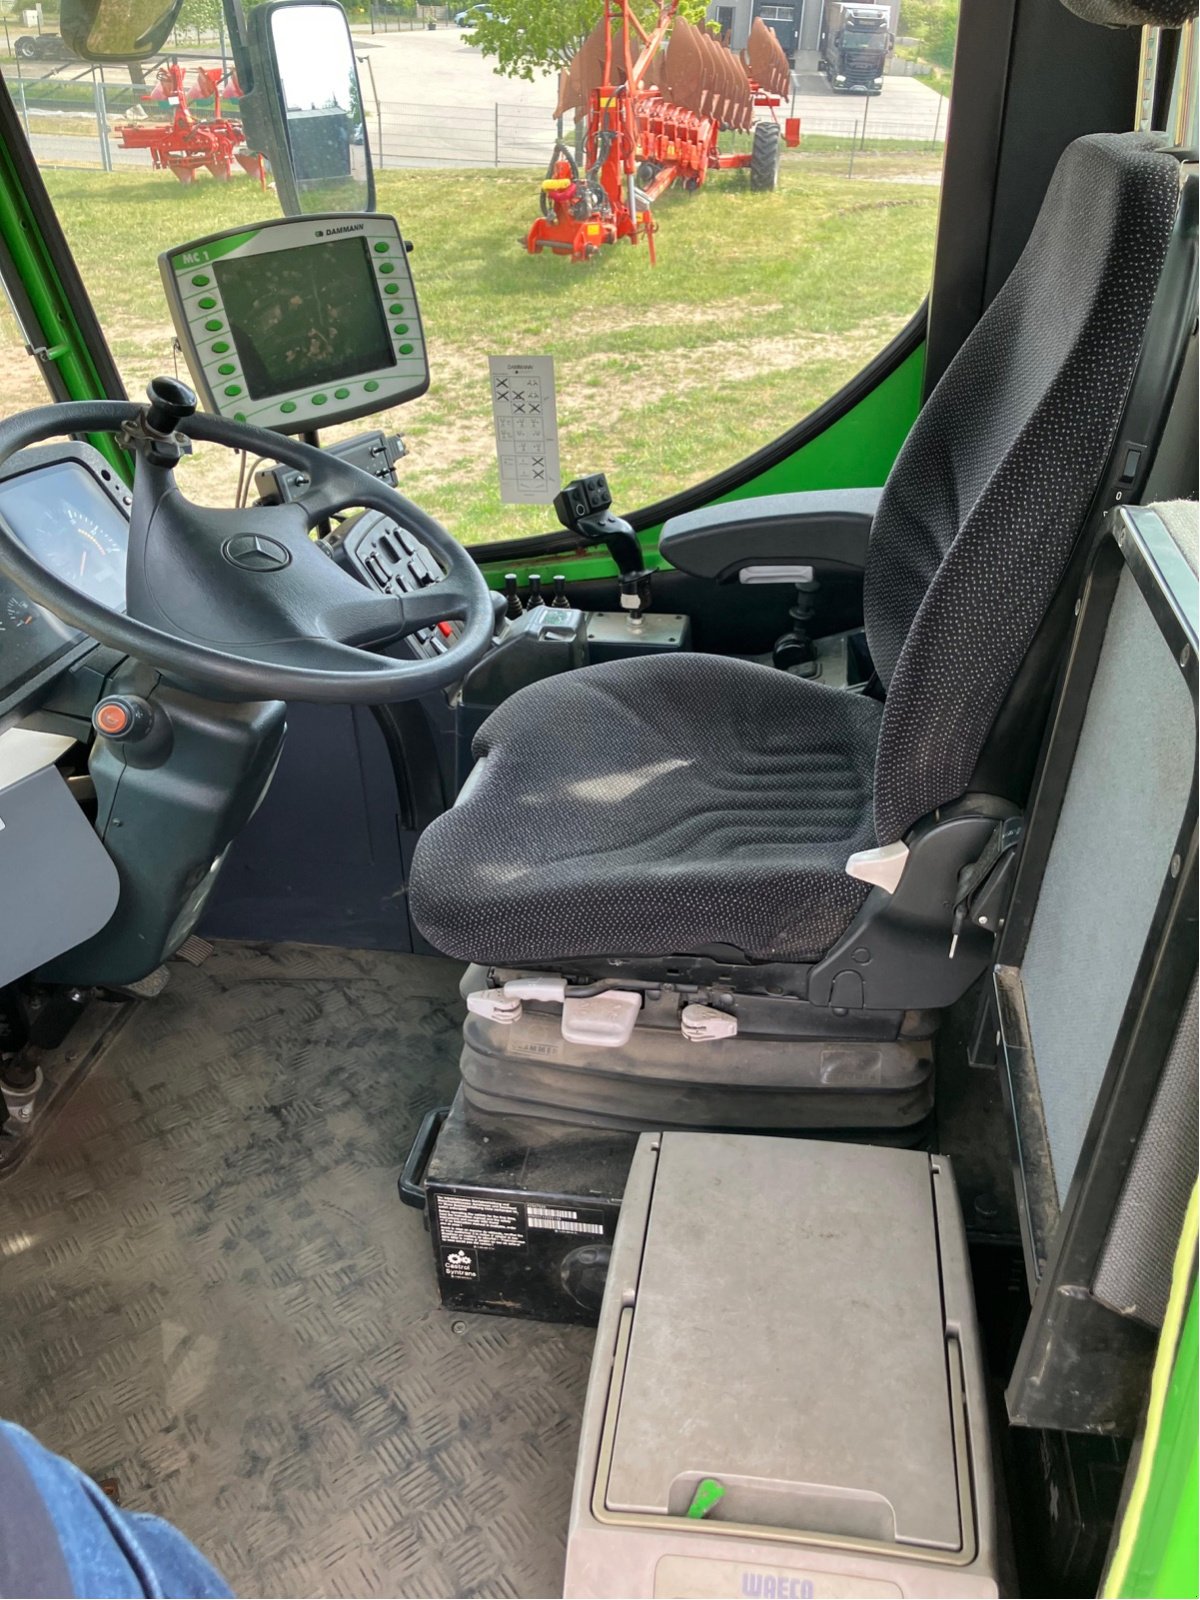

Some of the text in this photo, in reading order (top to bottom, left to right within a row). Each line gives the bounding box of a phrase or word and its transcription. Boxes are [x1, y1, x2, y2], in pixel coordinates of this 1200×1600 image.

[326, 223, 364, 236] DAMMANN
[182, 250, 210, 265] MC 1
[444, 1262, 470, 1271] Castrol
[445, 1268, 477, 1277] Syntrans
[742, 1572, 815, 1599] WAECO
